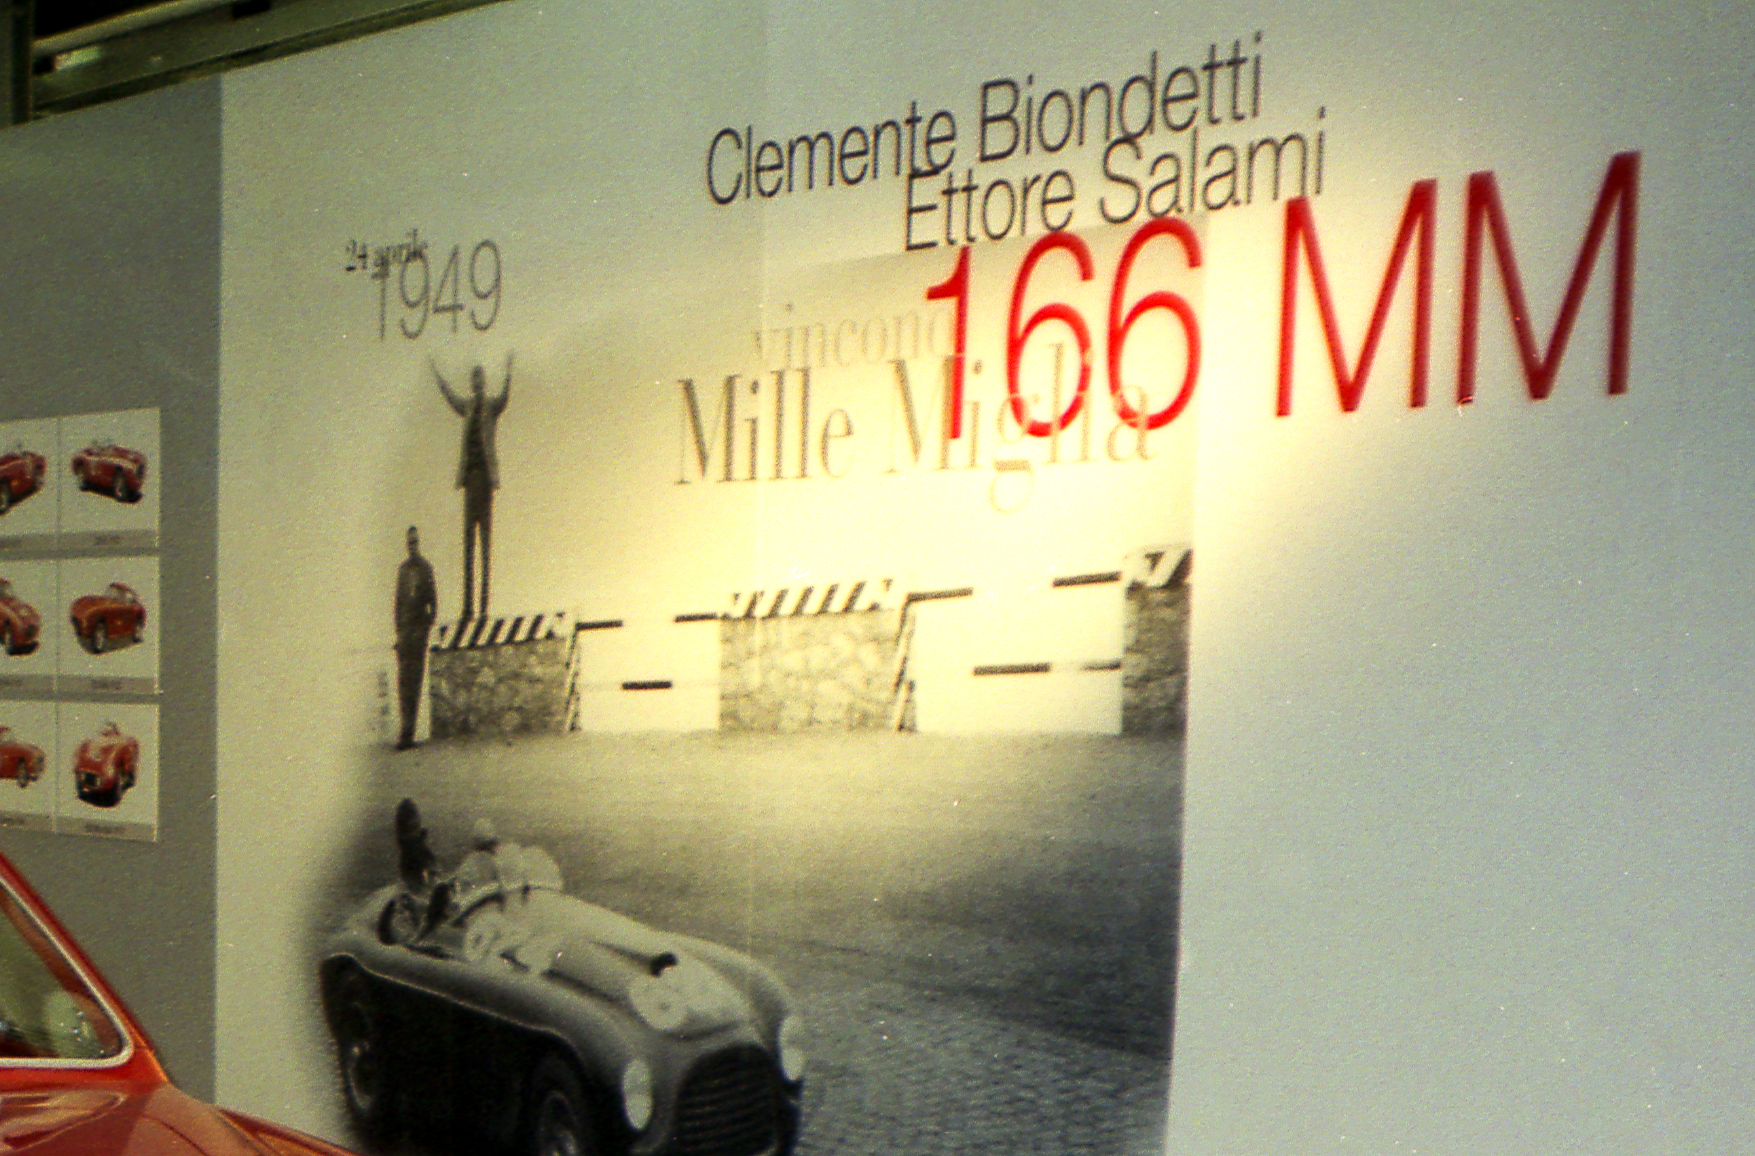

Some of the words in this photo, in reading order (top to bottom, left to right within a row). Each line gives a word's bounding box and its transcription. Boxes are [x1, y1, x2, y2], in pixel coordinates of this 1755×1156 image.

[706, 101, 956, 205] Clemente
[980, 31, 1262, 164] Biondetti
[905, 164, 1075, 252] Ettore
[1099, 107, 1326, 223] Salami
[372, 240, 501, 340] 1949
[926, 217, 1203, 440] 166
[1275, 151, 1642, 417] MM
[673, 366, 854, 485] Mille
[884, 342, 1157, 514] Miglia
